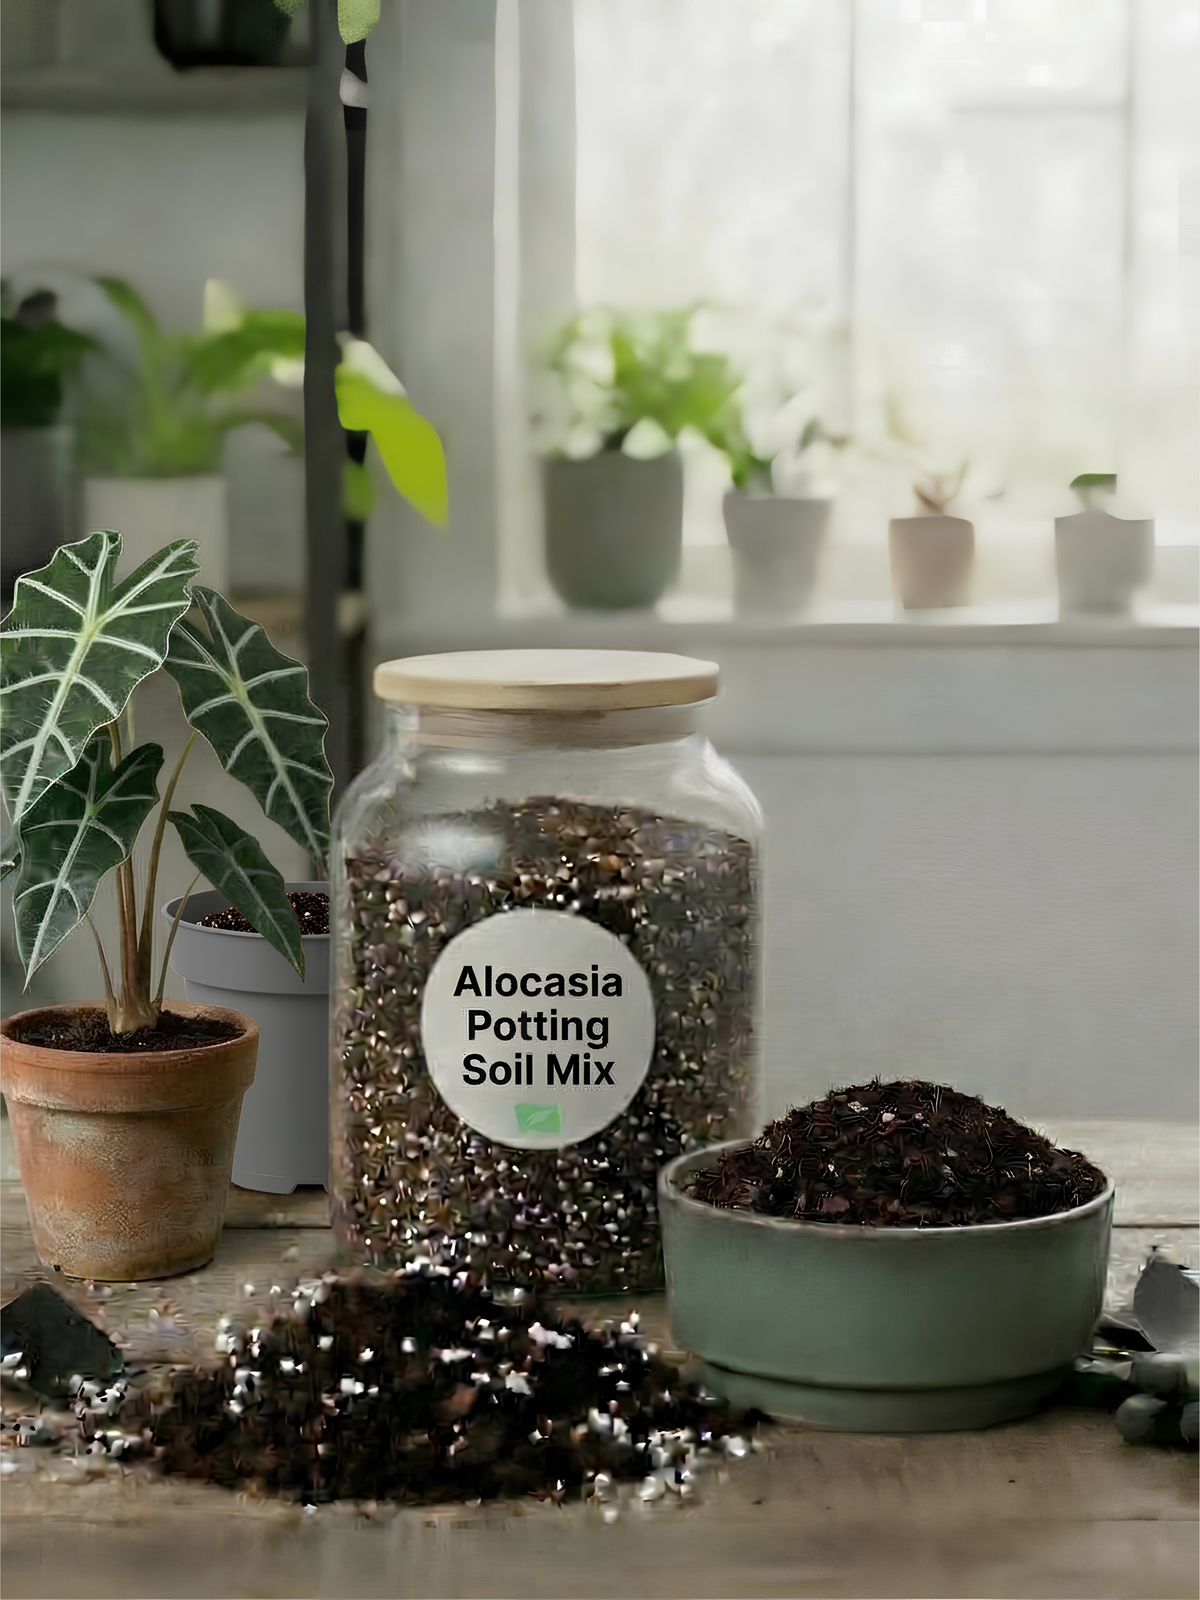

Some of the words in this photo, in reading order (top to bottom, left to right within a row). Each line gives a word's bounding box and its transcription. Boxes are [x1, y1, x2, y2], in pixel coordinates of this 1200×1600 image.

[453, 964, 622, 997] Alocasia
[468, 1009, 609, 1049] Potting
[462, 1053, 533, 1085] Soil
[547, 1053, 615, 1085] Mix
